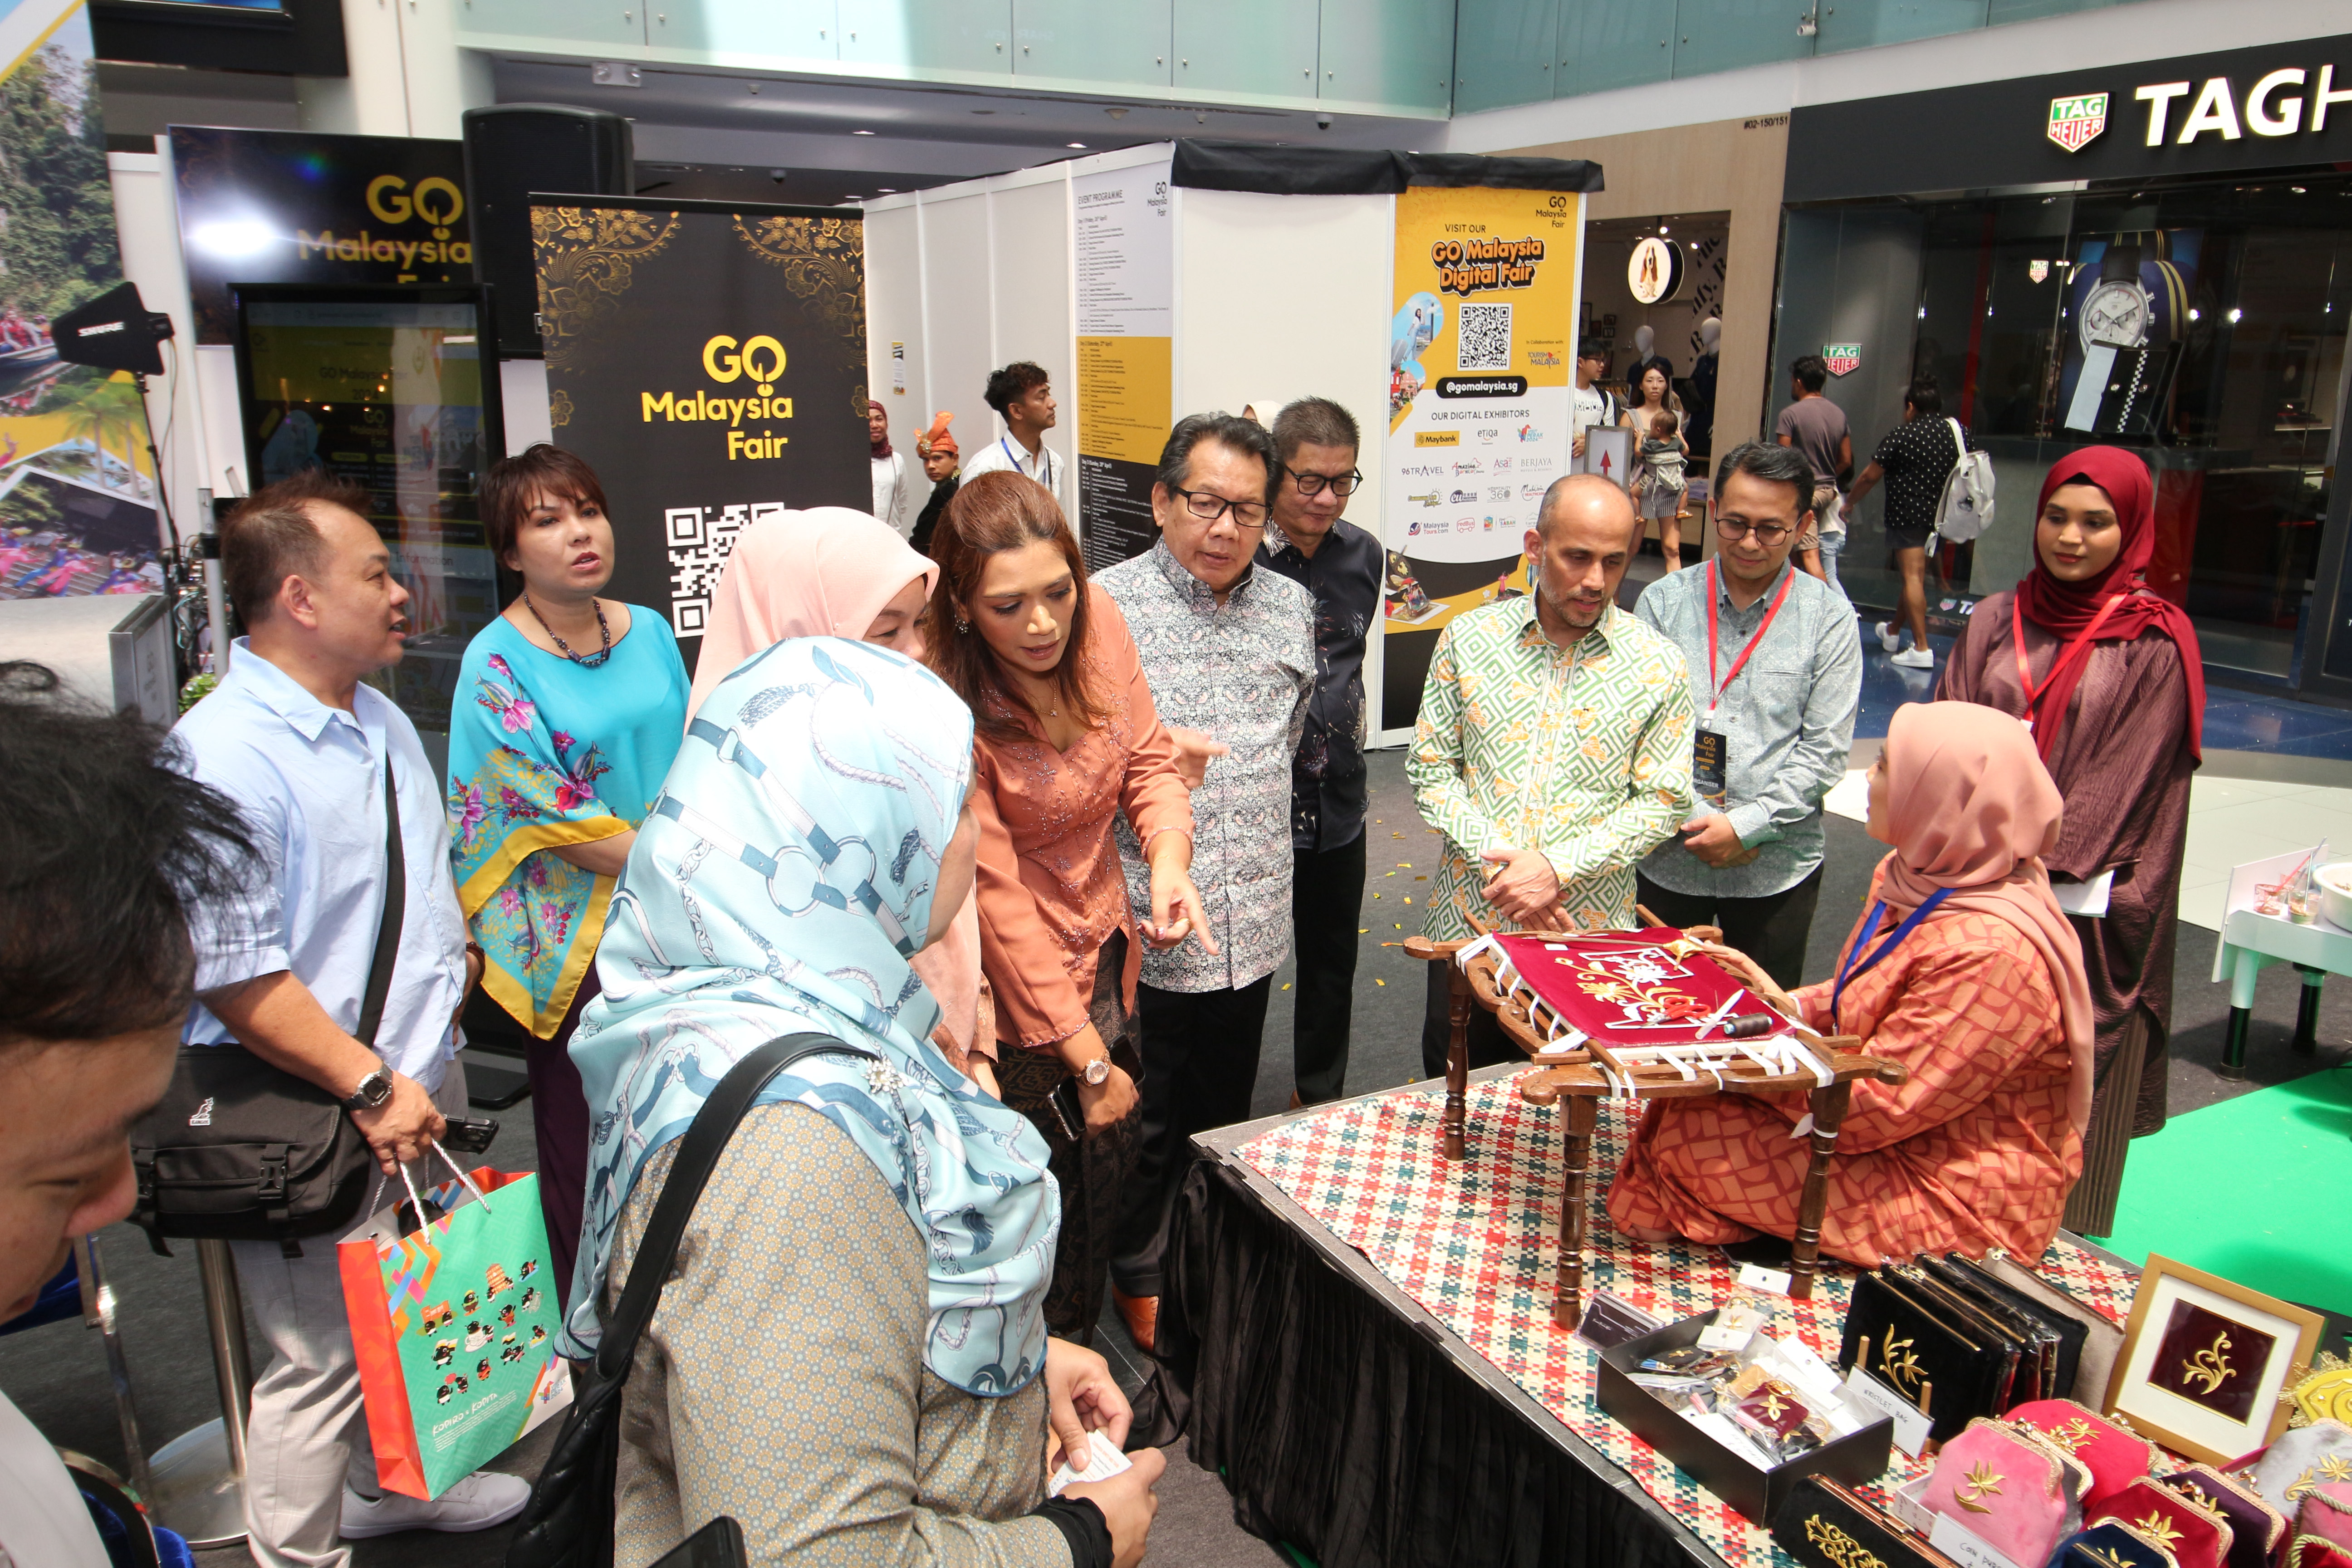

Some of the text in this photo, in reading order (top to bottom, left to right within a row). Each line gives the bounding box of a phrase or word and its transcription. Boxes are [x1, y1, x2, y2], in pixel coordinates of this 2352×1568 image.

[2056, 98, 2102, 119] TAG
[1744, 116, 1788, 129] #02-150/151
[2051, 120, 2101, 147] HEUER
[1156, 181, 1167, 195] GO
[366, 175, 463, 225] GO
[1078, 189, 1123, 205] EVENT PROGRAMME
[1147, 196, 1167, 207] Malaysia
[1549, 196, 1566, 208] GO
[1157, 208, 1166, 216] Fair
[1536, 209, 1567, 219] Malaysia
[1445, 224, 1486, 233] VISIT OUR
[297, 227, 472, 270] Malaysia
[1432, 236, 1543, 264] GO Malaysia
[1440, 262, 1534, 293] Digital Fair
[78, 321, 124, 337] SHURE
[703, 335, 787, 383] GO
[1827, 348, 1857, 357] TAG
[1446, 380, 1518, 394] @gomalaysia.sg
[641, 384, 793, 427] Malaysia
[1431, 410, 1530, 421] OUR DIGITAL EXHIBITORS
[727, 430, 789, 461] Fair
[1426, 435, 1456, 444] Maybank
[1521, 458, 1552, 467] BERJAYA
[1704, 736, 1715, 745] GO
[1694, 778, 1719, 789] RGANISER
[1864, 1389, 1908, 1424] WRISTLET BAG
[432, 1413, 464, 1437] KOPIRO
[471, 1393, 498, 1414] KOPITA
